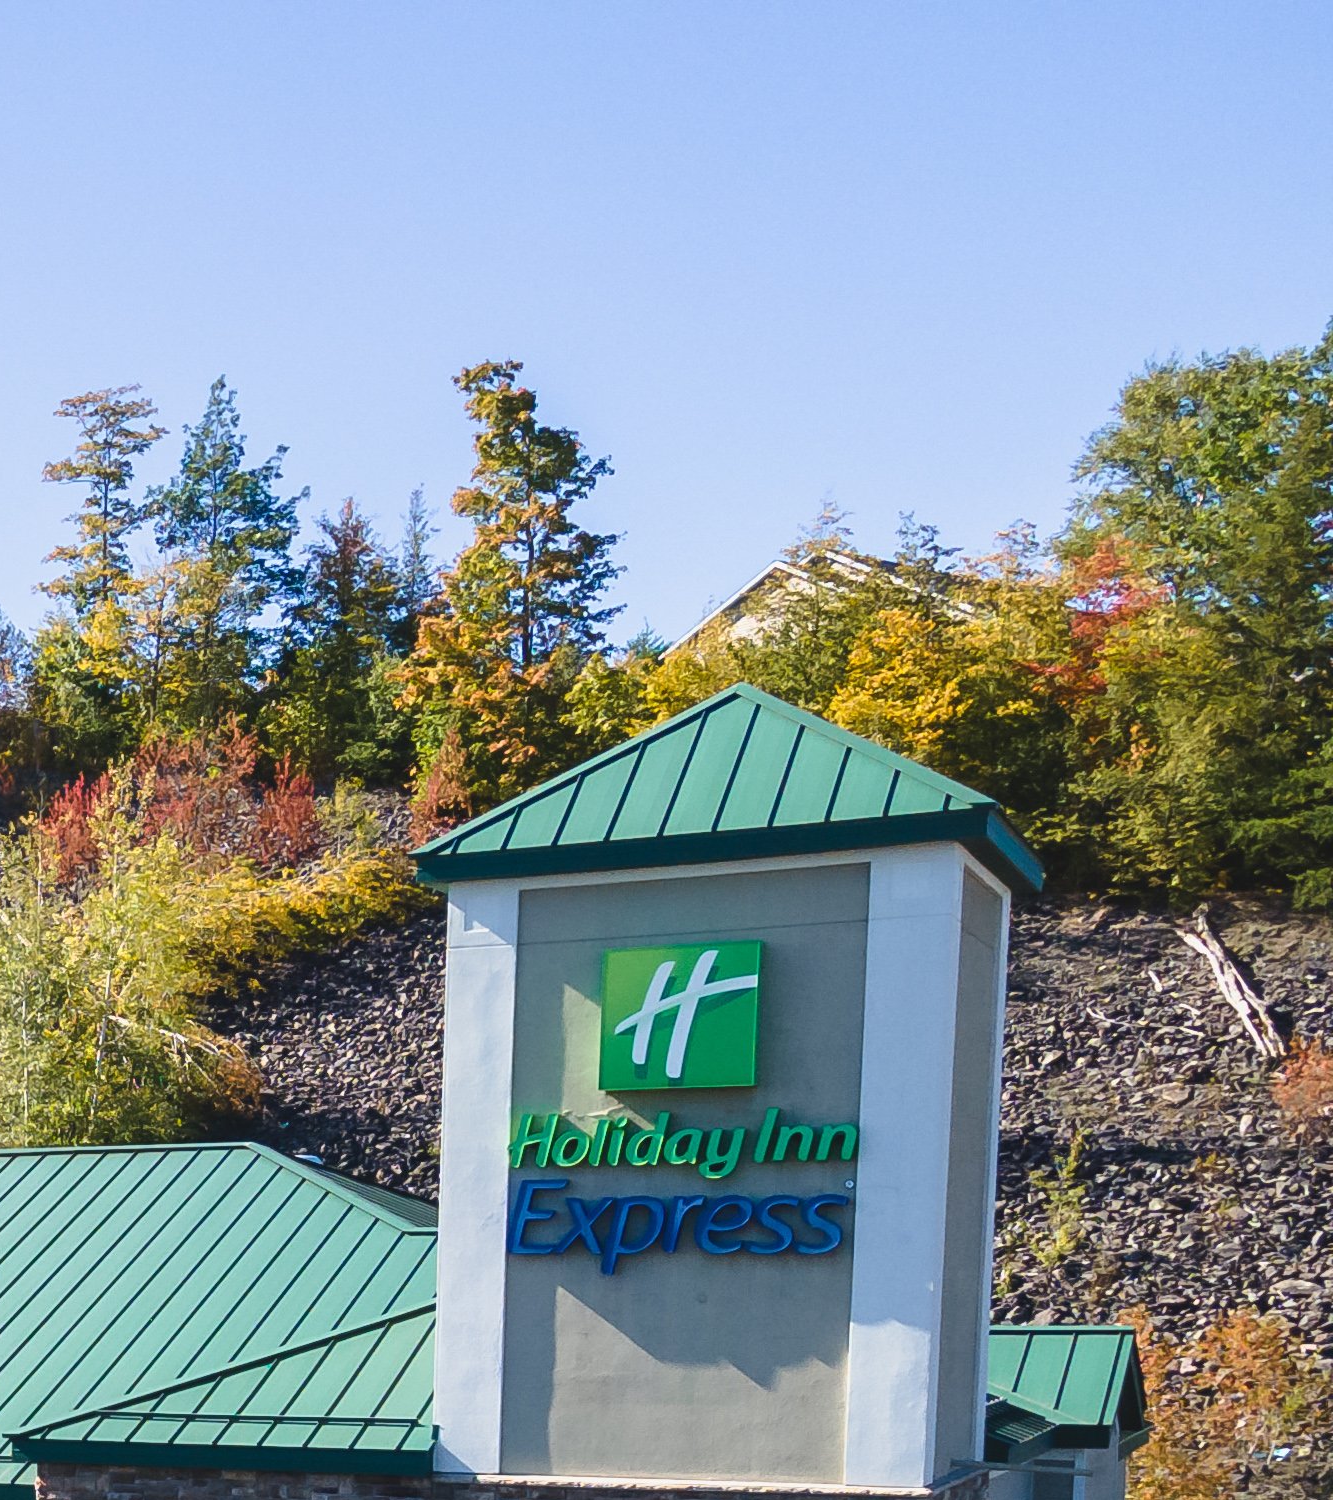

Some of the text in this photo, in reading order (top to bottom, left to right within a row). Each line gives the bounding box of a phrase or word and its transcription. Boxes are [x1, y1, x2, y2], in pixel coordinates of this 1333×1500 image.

[614, 949, 758, 1079] H
[508, 1107, 859, 1179] Holiday Inn
[508, 1179, 849, 1276] Express
